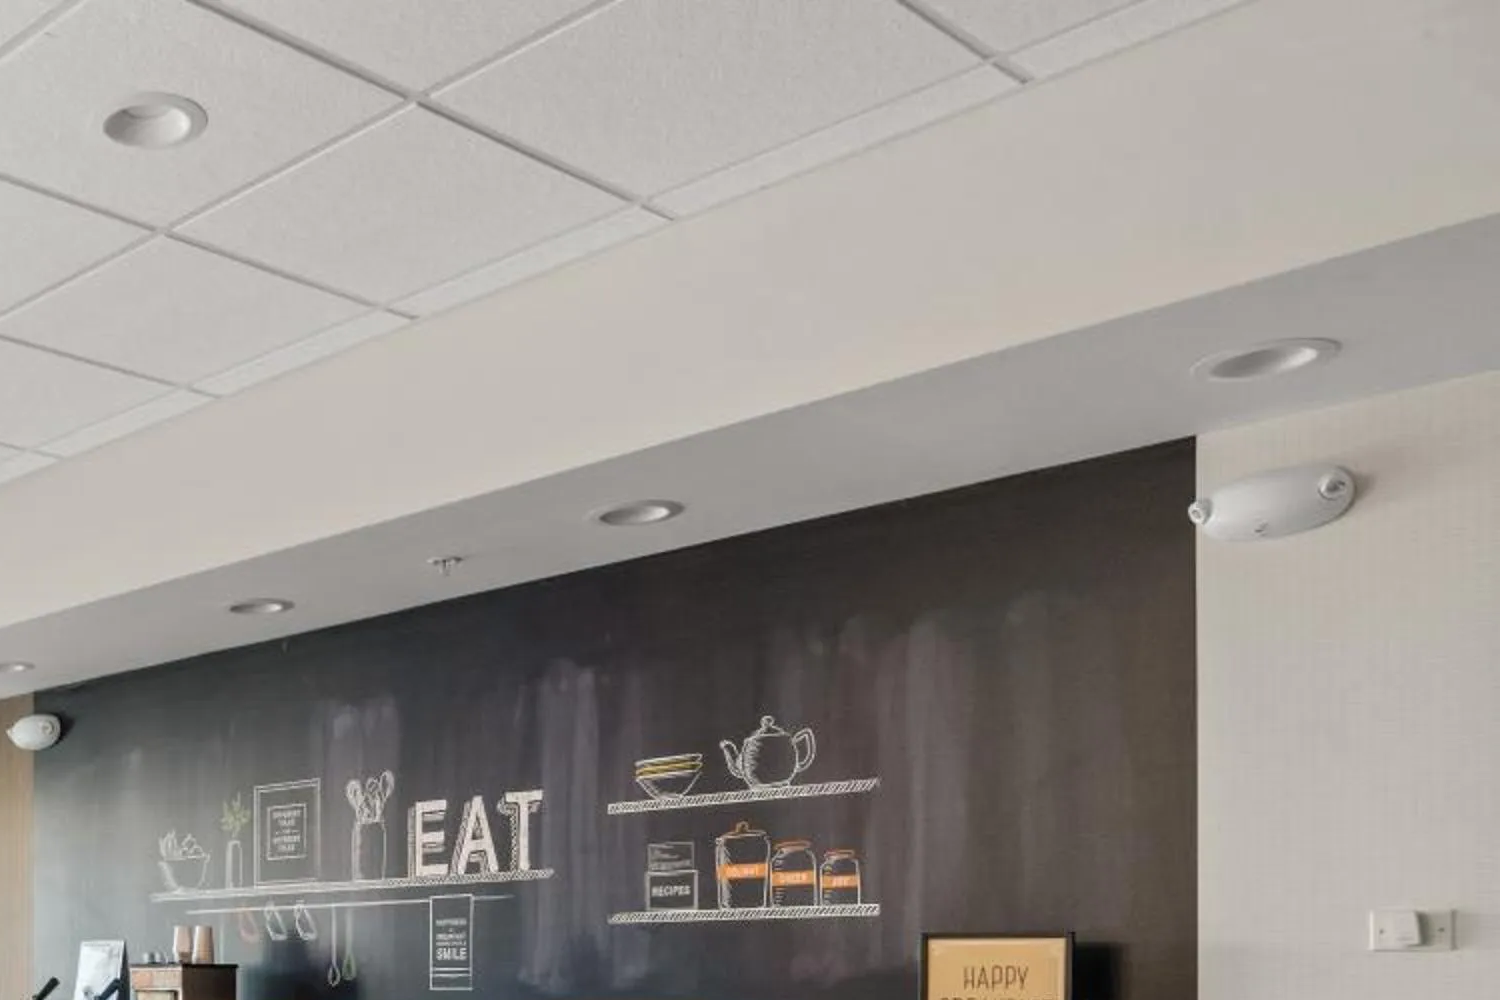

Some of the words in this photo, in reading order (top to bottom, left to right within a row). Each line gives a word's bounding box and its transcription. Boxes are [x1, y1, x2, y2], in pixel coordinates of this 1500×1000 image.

[408, 789, 543, 877] EAT
[651, 885, 691, 897] RECIPES
[436, 947, 467, 960] SMILE
[963, 965, 1029, 990] HAPPY
